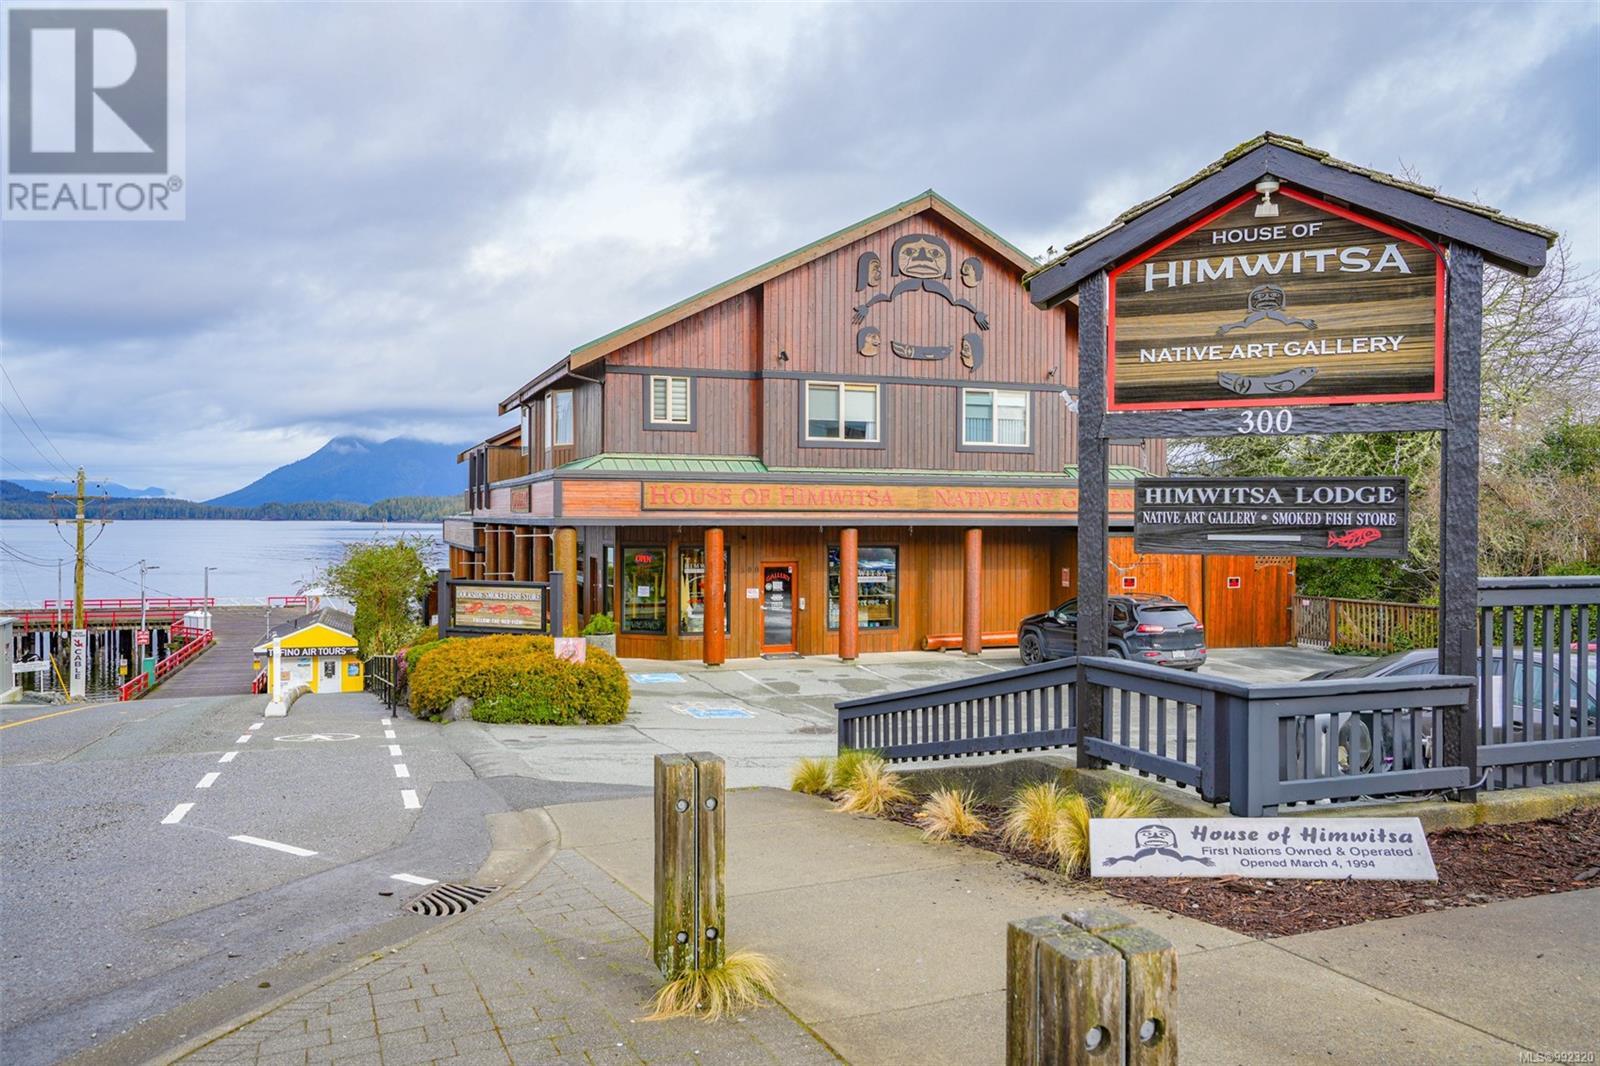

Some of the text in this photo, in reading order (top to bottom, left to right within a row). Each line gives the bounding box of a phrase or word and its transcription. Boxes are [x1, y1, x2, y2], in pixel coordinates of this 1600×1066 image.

[1212, 222, 1323, 245] HOUSE OF
[1144, 243, 1412, 292] HIMWITSA
[1139, 335, 1406, 363] NATIVE ART GALLERY
[1237, 409, 1293, 434] 300
[649, 484, 895, 507] HOUSE OF HIMWITSA
[935, 490, 1009, 508] NATIVE
[1015, 492, 1056, 508] ART
[1144, 487, 1284, 504] HIMWITSA
[1295, 486, 1397, 504] LODGE
[1142, 511, 1397, 526] NATIVE ART GALLERY SMOKED FISH STORE
[268, 647, 347, 656] TFINO AIR TOURS
[74, 649, 82, 679] CABLE
[1191, 825, 1414, 844] House of Himwitsa
[1201, 846, 1414, 858] First Nations Owned & Operated
[1240, 858, 1376, 870] Opened March 4, 1994
